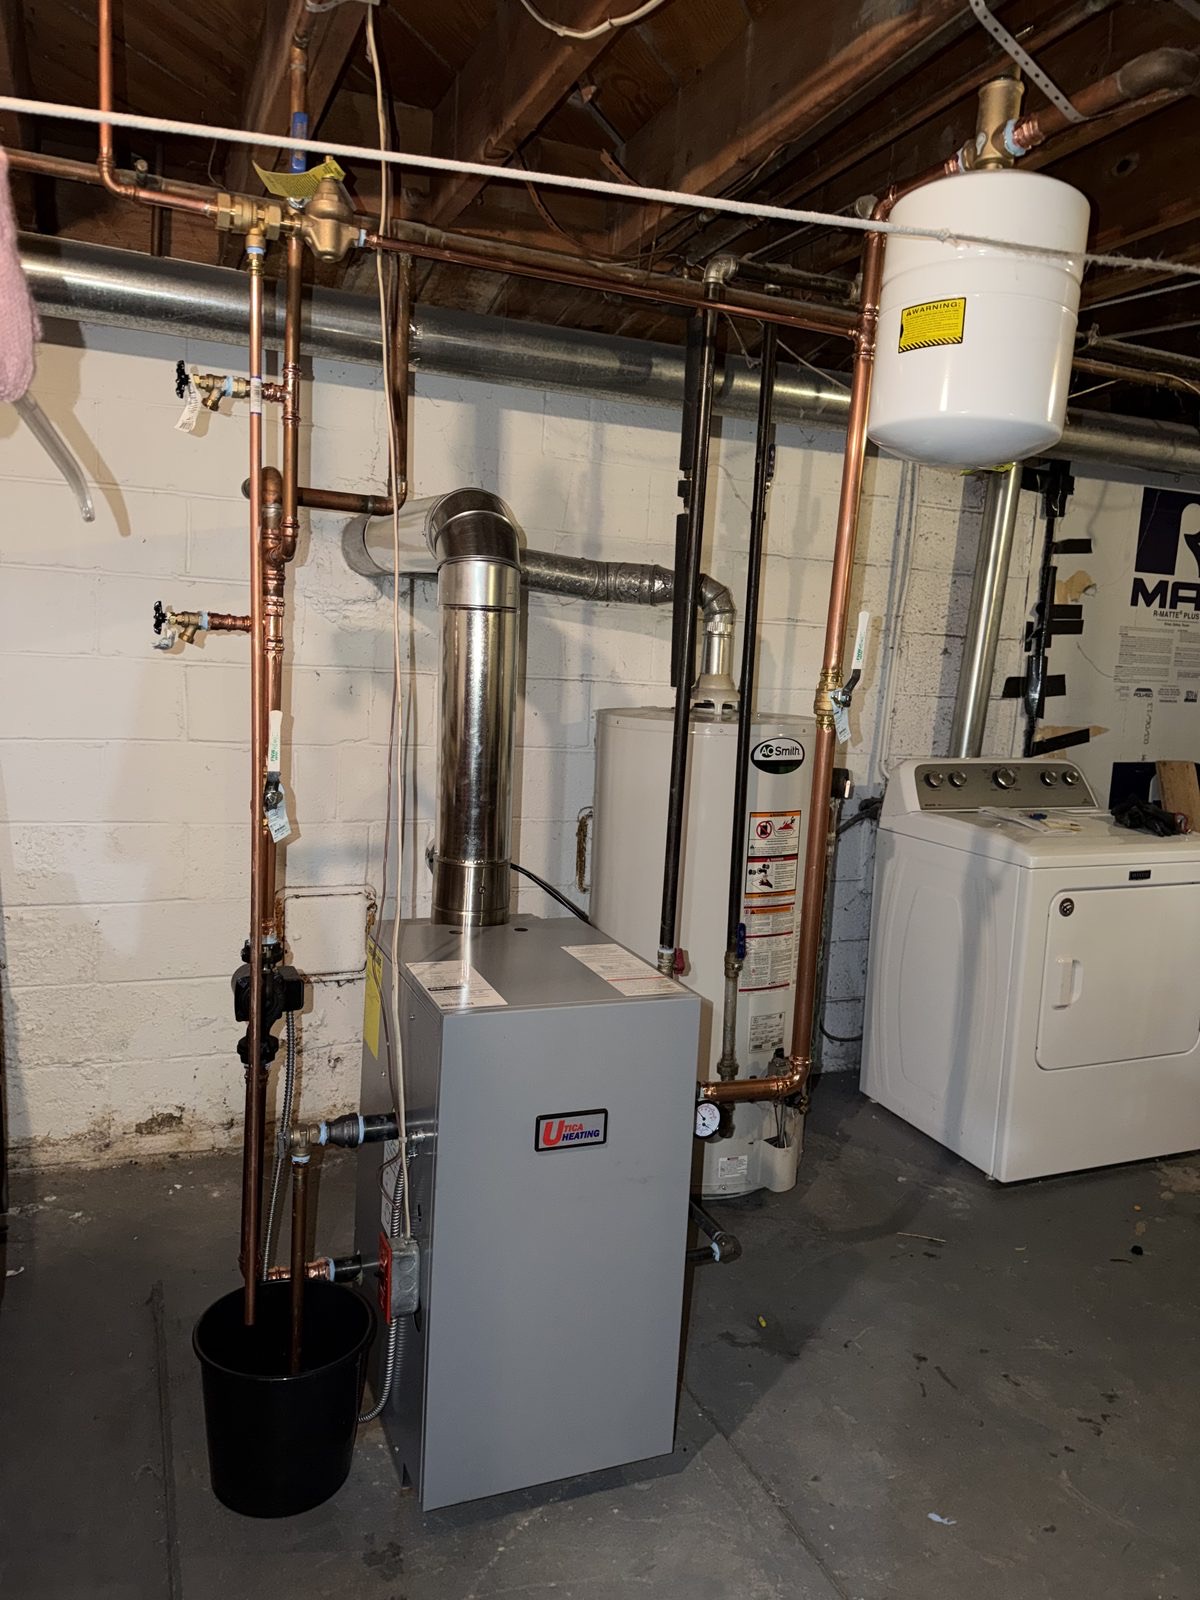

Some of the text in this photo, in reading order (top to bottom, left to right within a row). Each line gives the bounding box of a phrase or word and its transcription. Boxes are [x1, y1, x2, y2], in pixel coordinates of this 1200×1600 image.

[1183, 612, 1200, 620] PLUS
[775, 746, 800, 756] Smith
[543, 1119, 584, 1146] UTICA
[562, 1129, 600, 1141] HEATING
